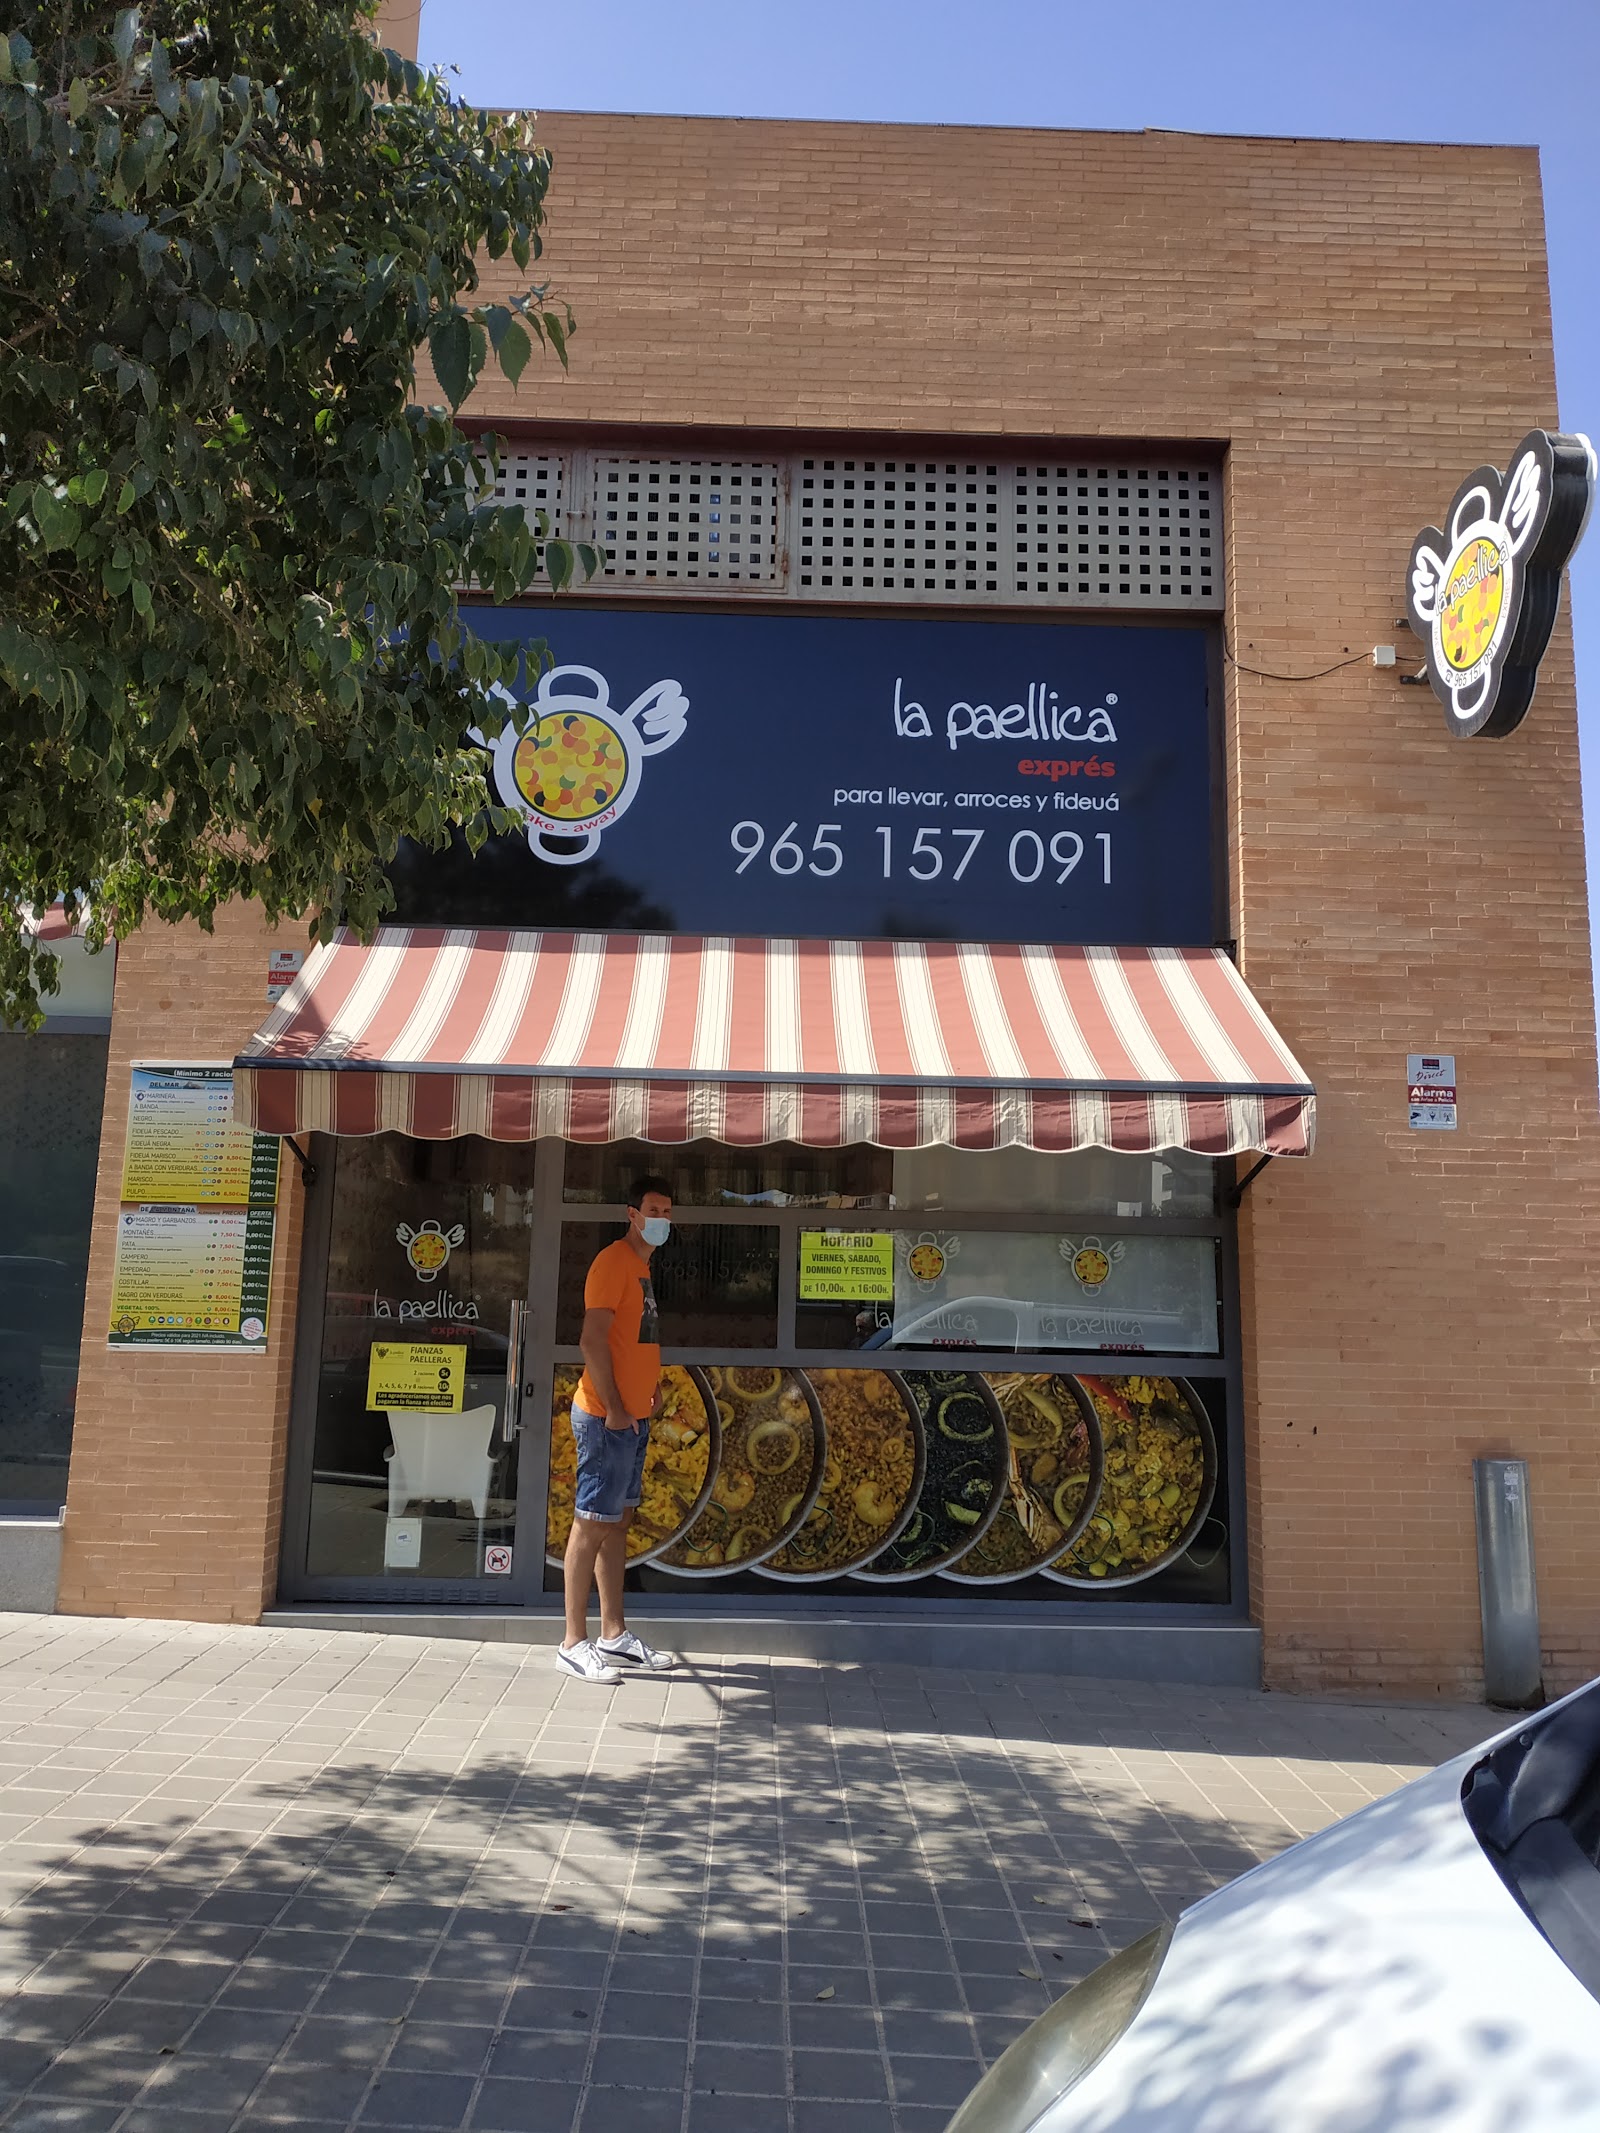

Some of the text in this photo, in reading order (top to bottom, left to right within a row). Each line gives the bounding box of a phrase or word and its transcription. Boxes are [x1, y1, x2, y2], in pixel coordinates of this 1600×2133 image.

[1434, 540, 1509, 616] la paellica
[1454, 641, 1498, 687] 965 157 091
[893, 677, 1118, 750] la paellica
[1017, 755, 1116, 782] exprés
[833, 786, 1121, 813] para llevar, arroces y fideuá
[525, 806, 617, 833] ake away
[729, 819, 1113, 886] 965 157 091
[1410, 1087, 1454, 1097] Alarma
[820, 1236, 874, 1248] HORARIO
[806, 1265, 887, 1276] DOMINGO Y FESTIVOS
[812, 1253, 881, 1264] VIERNES, SABADO,
[804, 1284, 812, 1292] DE
[373, 1288, 479, 1324] la paellica
[875, 1301, 892, 1328] la
[409, 1355, 452, 1364] PAELLERAS
[410, 1346, 444, 1354] FIANZAS
